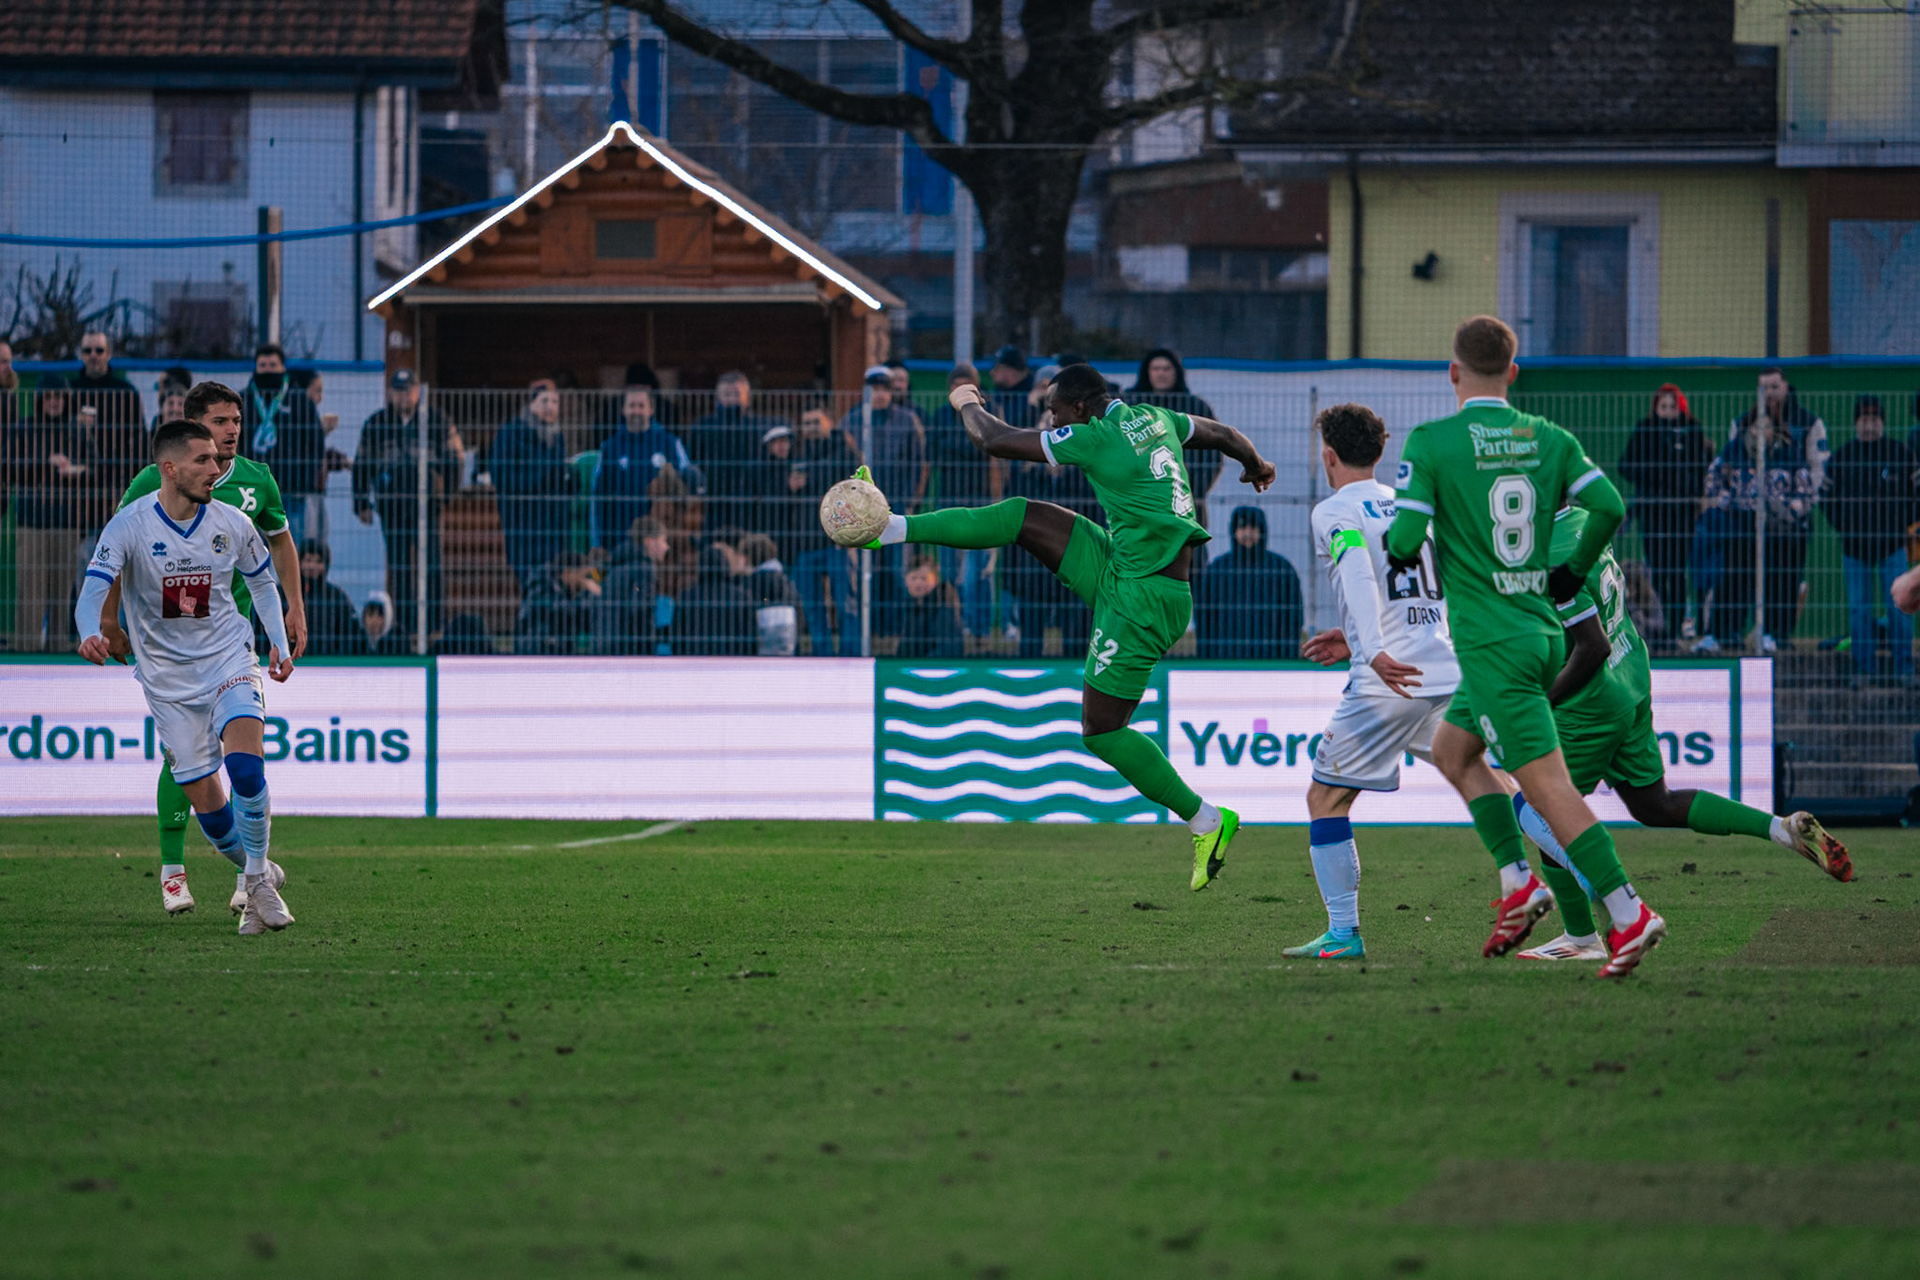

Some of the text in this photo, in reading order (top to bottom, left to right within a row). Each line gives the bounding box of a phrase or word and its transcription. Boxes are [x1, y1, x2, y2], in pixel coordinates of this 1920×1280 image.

[1126, 420, 1165, 446] Partn
[1468, 422, 1513, 438] Shaw
[1473, 439, 1539, 457] Partners
[1150, 445, 1192, 517] 2
[1489, 474, 1536, 568] 8
[90, 561, 117, 573] casino
[164, 575, 210, 587] OTTO'S
[1097, 639, 1119, 666] 2
[263, 716, 410, 762] Bains
[1480, 714, 1498, 744] 8
[174, 811, 186, 821] 25
